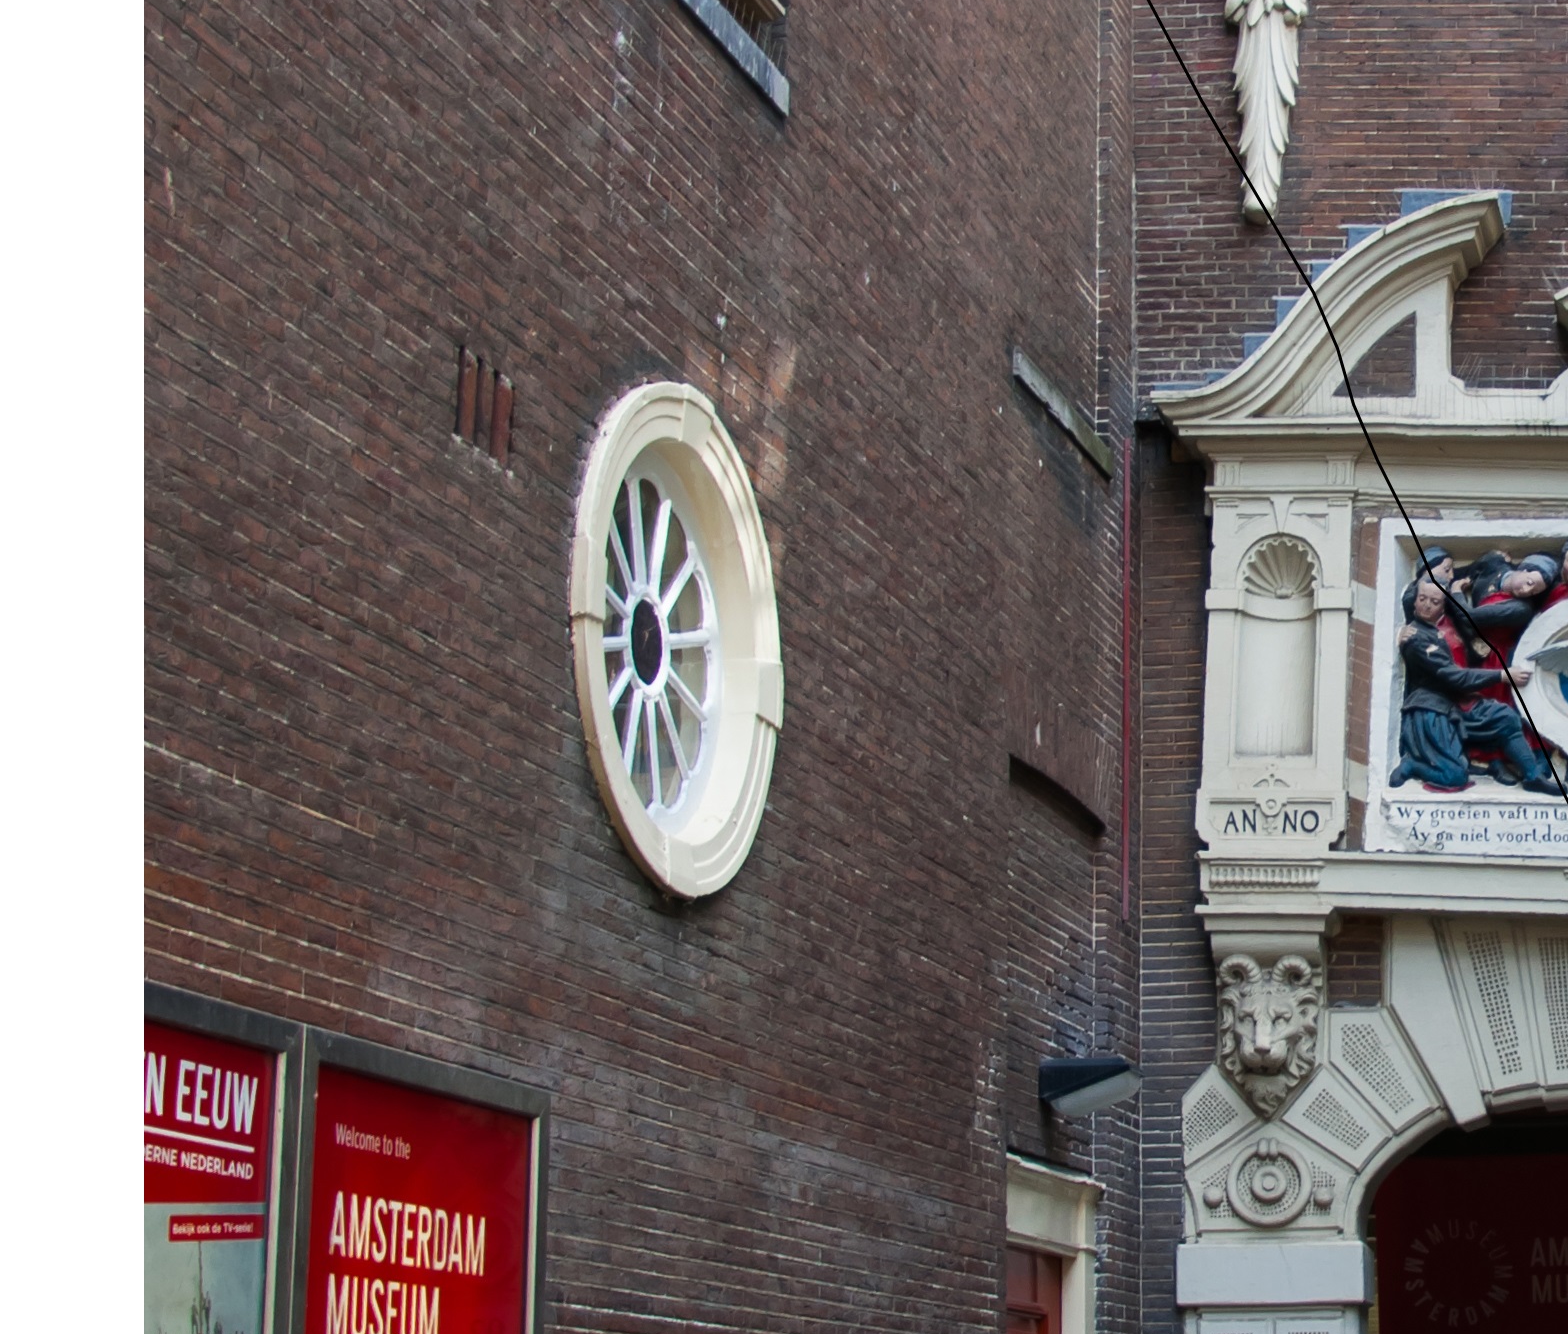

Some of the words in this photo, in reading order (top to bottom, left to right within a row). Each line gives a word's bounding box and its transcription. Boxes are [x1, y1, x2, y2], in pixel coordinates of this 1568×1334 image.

[1397, 806, 1424, 824] Wy
[1430, 807, 1490, 827] groeien
[1534, 809, 1549, 820] in
[1407, 825, 1430, 846] Ay
[1436, 830, 1454, 850] ga
[1460, 827, 1490, 842] niet
[144, 1051, 167, 1117] N
[175, 1059, 259, 1135] EEUW
[335, 1122, 381, 1154] Welcome
[382, 1133, 393, 1156] to
[395, 1137, 412, 1160] the
[144, 1143, 178, 1167] ERNE
[181, 1150, 255, 1181] NEDERLAND
[172, 1222, 196, 1236] Bekijk
[196, 1221, 211, 1234] ook
[211, 1221, 222, 1234] de
[329, 1190, 486, 1277] AMSTERDAM
